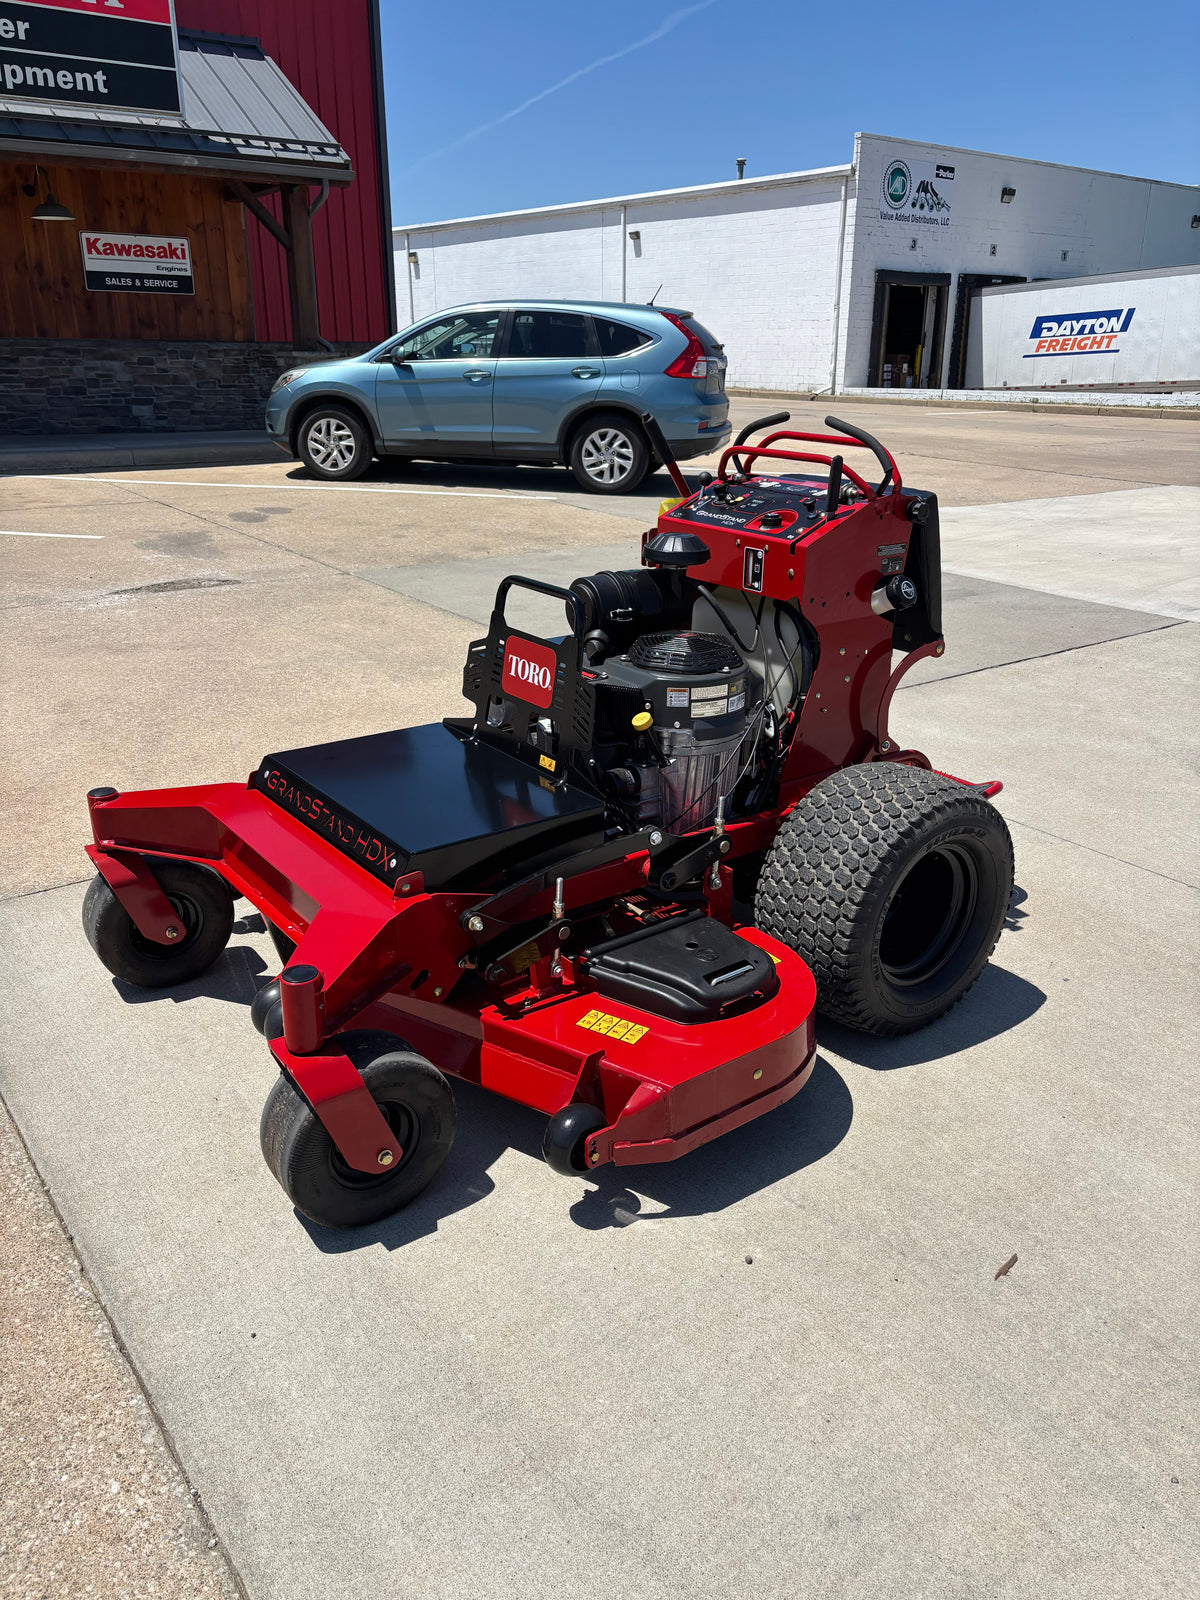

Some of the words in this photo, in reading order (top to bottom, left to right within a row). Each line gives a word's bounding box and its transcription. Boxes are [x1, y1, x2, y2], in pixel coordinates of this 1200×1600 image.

[0, 63, 109, 94] pment
[880, 211, 894, 220] Value
[895, 213, 910, 223] Added
[911, 214, 939, 226] Distributors,
[940, 217, 950, 226] LLC
[85, 237, 187, 260] Kawasaki
[911, 239, 917, 249] 3
[991, 245, 997, 255] 2
[156, 265, 188, 273] Engines
[105, 277, 133, 286] SALES
[135, 279, 141, 287] &
[144, 279, 179, 288] SERVICE
[1040, 310, 1127, 338] DAYTON
[1035, 335, 1118, 353] FREIGHT
[508, 654, 551, 689] TORO
[352, 830, 396, 872] HDX
